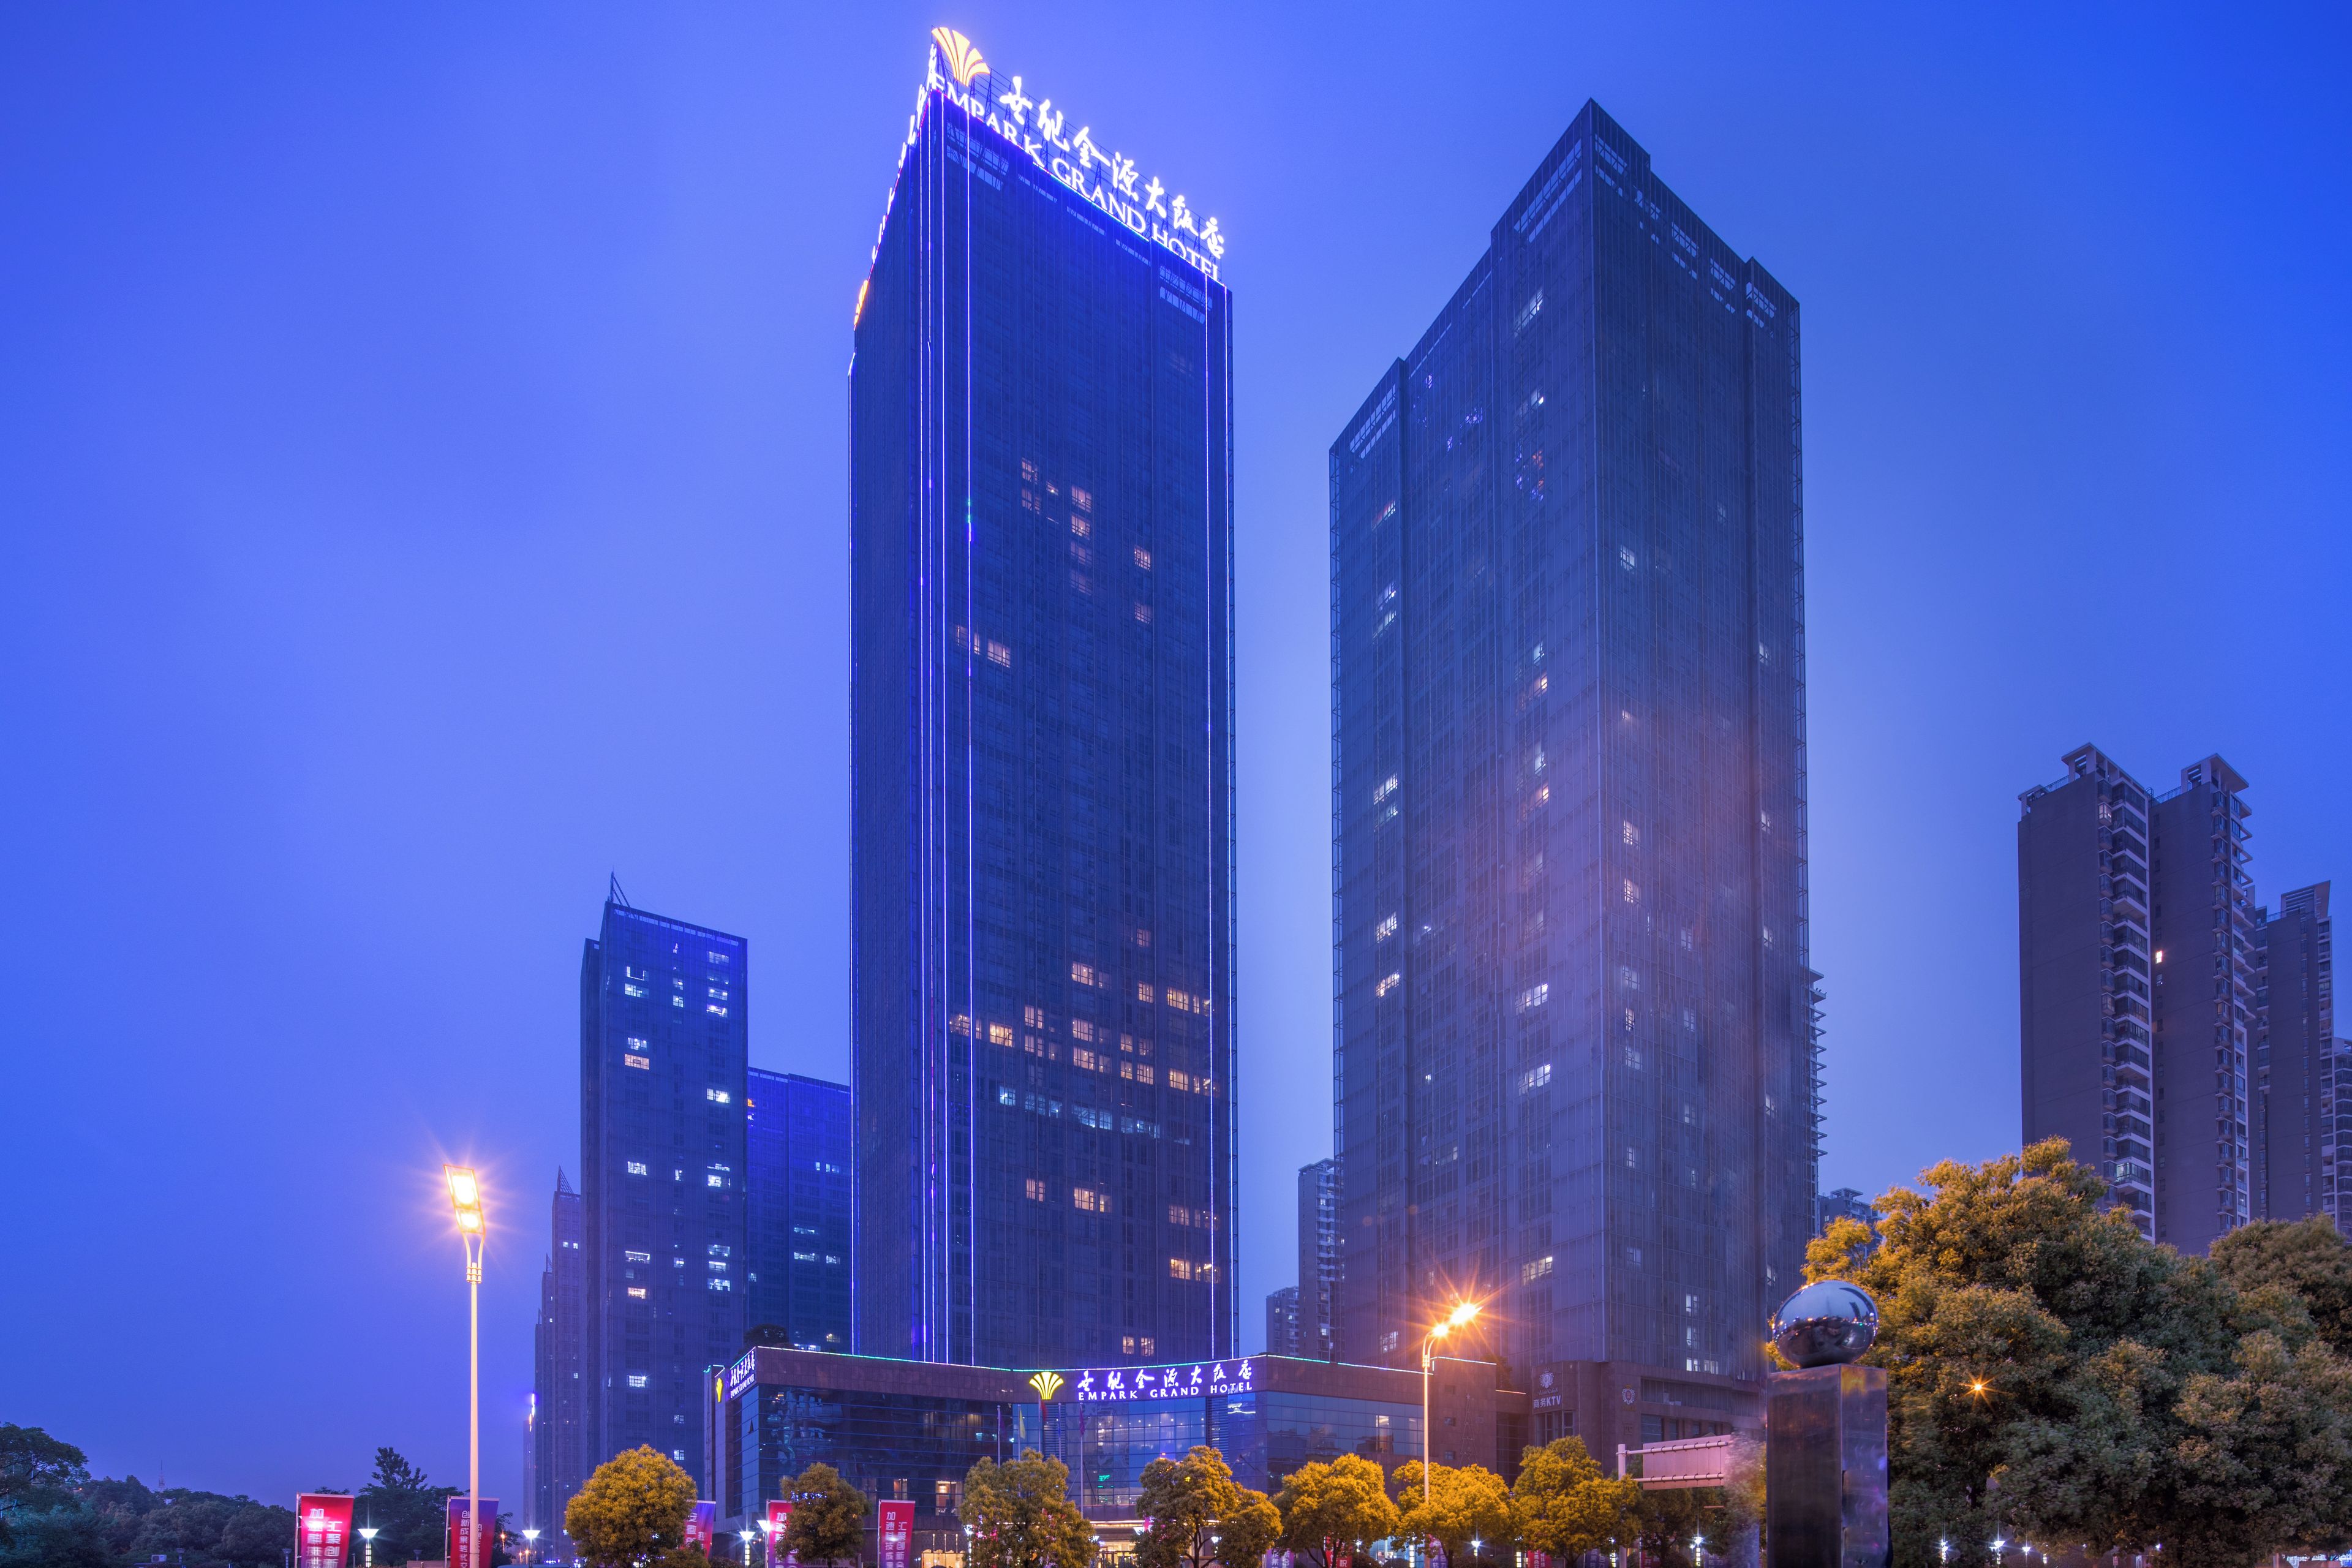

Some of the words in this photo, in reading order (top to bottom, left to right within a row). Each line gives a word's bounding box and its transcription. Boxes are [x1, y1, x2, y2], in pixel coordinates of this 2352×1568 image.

[932, 72, 1044, 167] EMPARK
[1052, 158, 1146, 233] GRAND
[1152, 223, 1218, 281] HOTEL
[1000, 76, 1224, 259] 世纪金源大饭店
[1077, 1360, 1252, 1392] 世纪金源大饭店
[1078, 1390, 1138, 1401] EMPARK
[1150, 1386, 1199, 1398] GRAND
[1210, 1381, 1253, 1394] HOTEL
